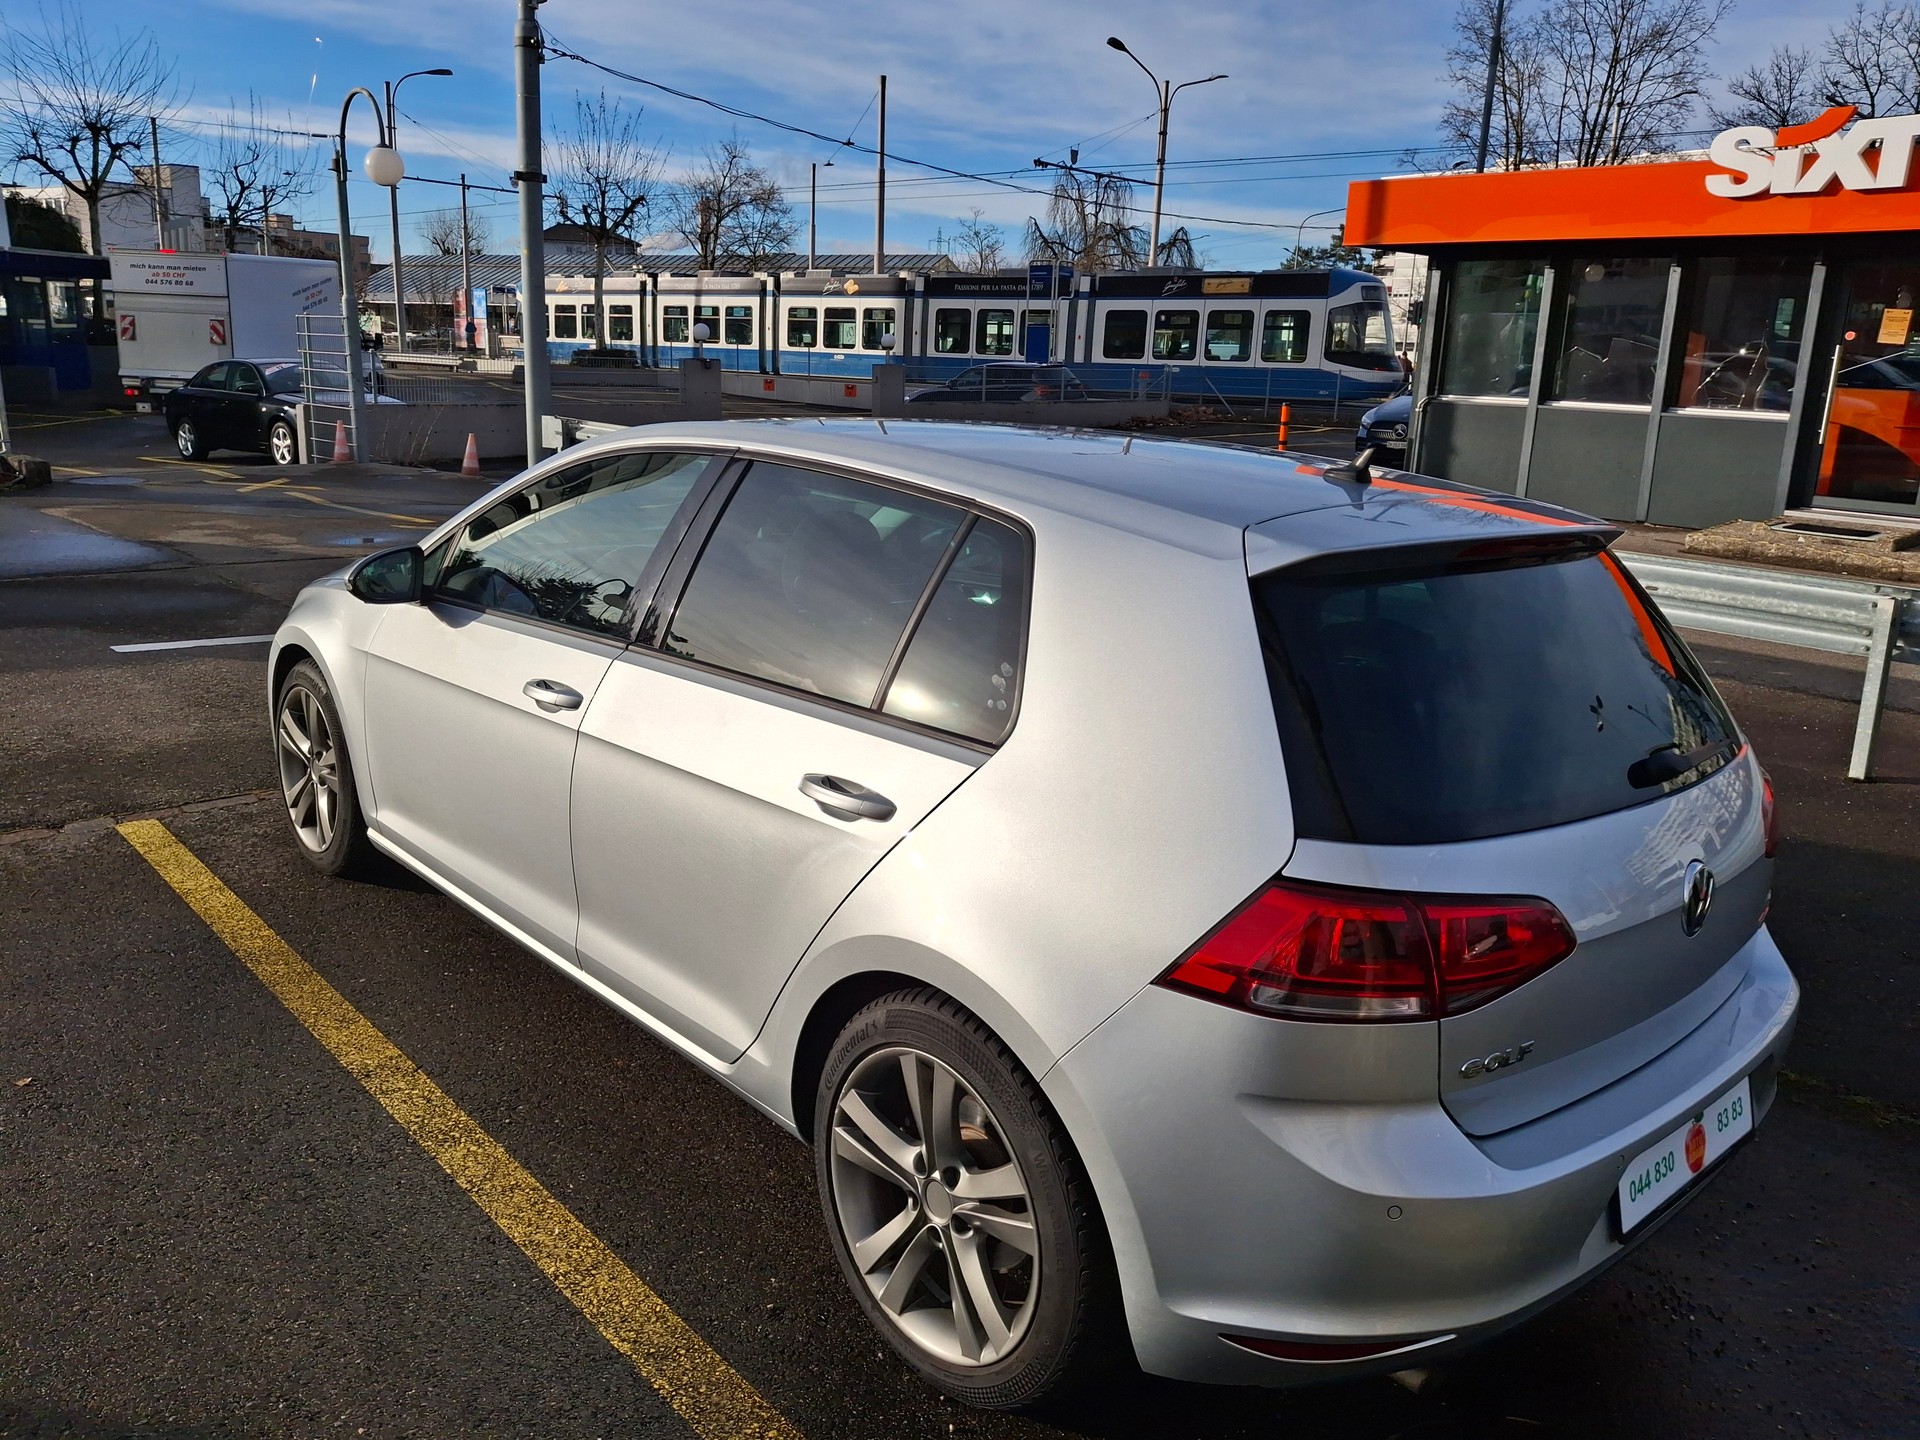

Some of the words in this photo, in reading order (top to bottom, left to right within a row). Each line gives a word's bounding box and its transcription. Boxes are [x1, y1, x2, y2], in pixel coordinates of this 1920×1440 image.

[824, 1022, 870, 1091] Continental
[1459, 1040, 1535, 1079] GOLF
[1717, 1107, 1729, 1132] 83
[1731, 1096, 1743, 1120] 83
[1629, 1168, 1651, 1203] 044
[1654, 1151, 1675, 1183] 830
